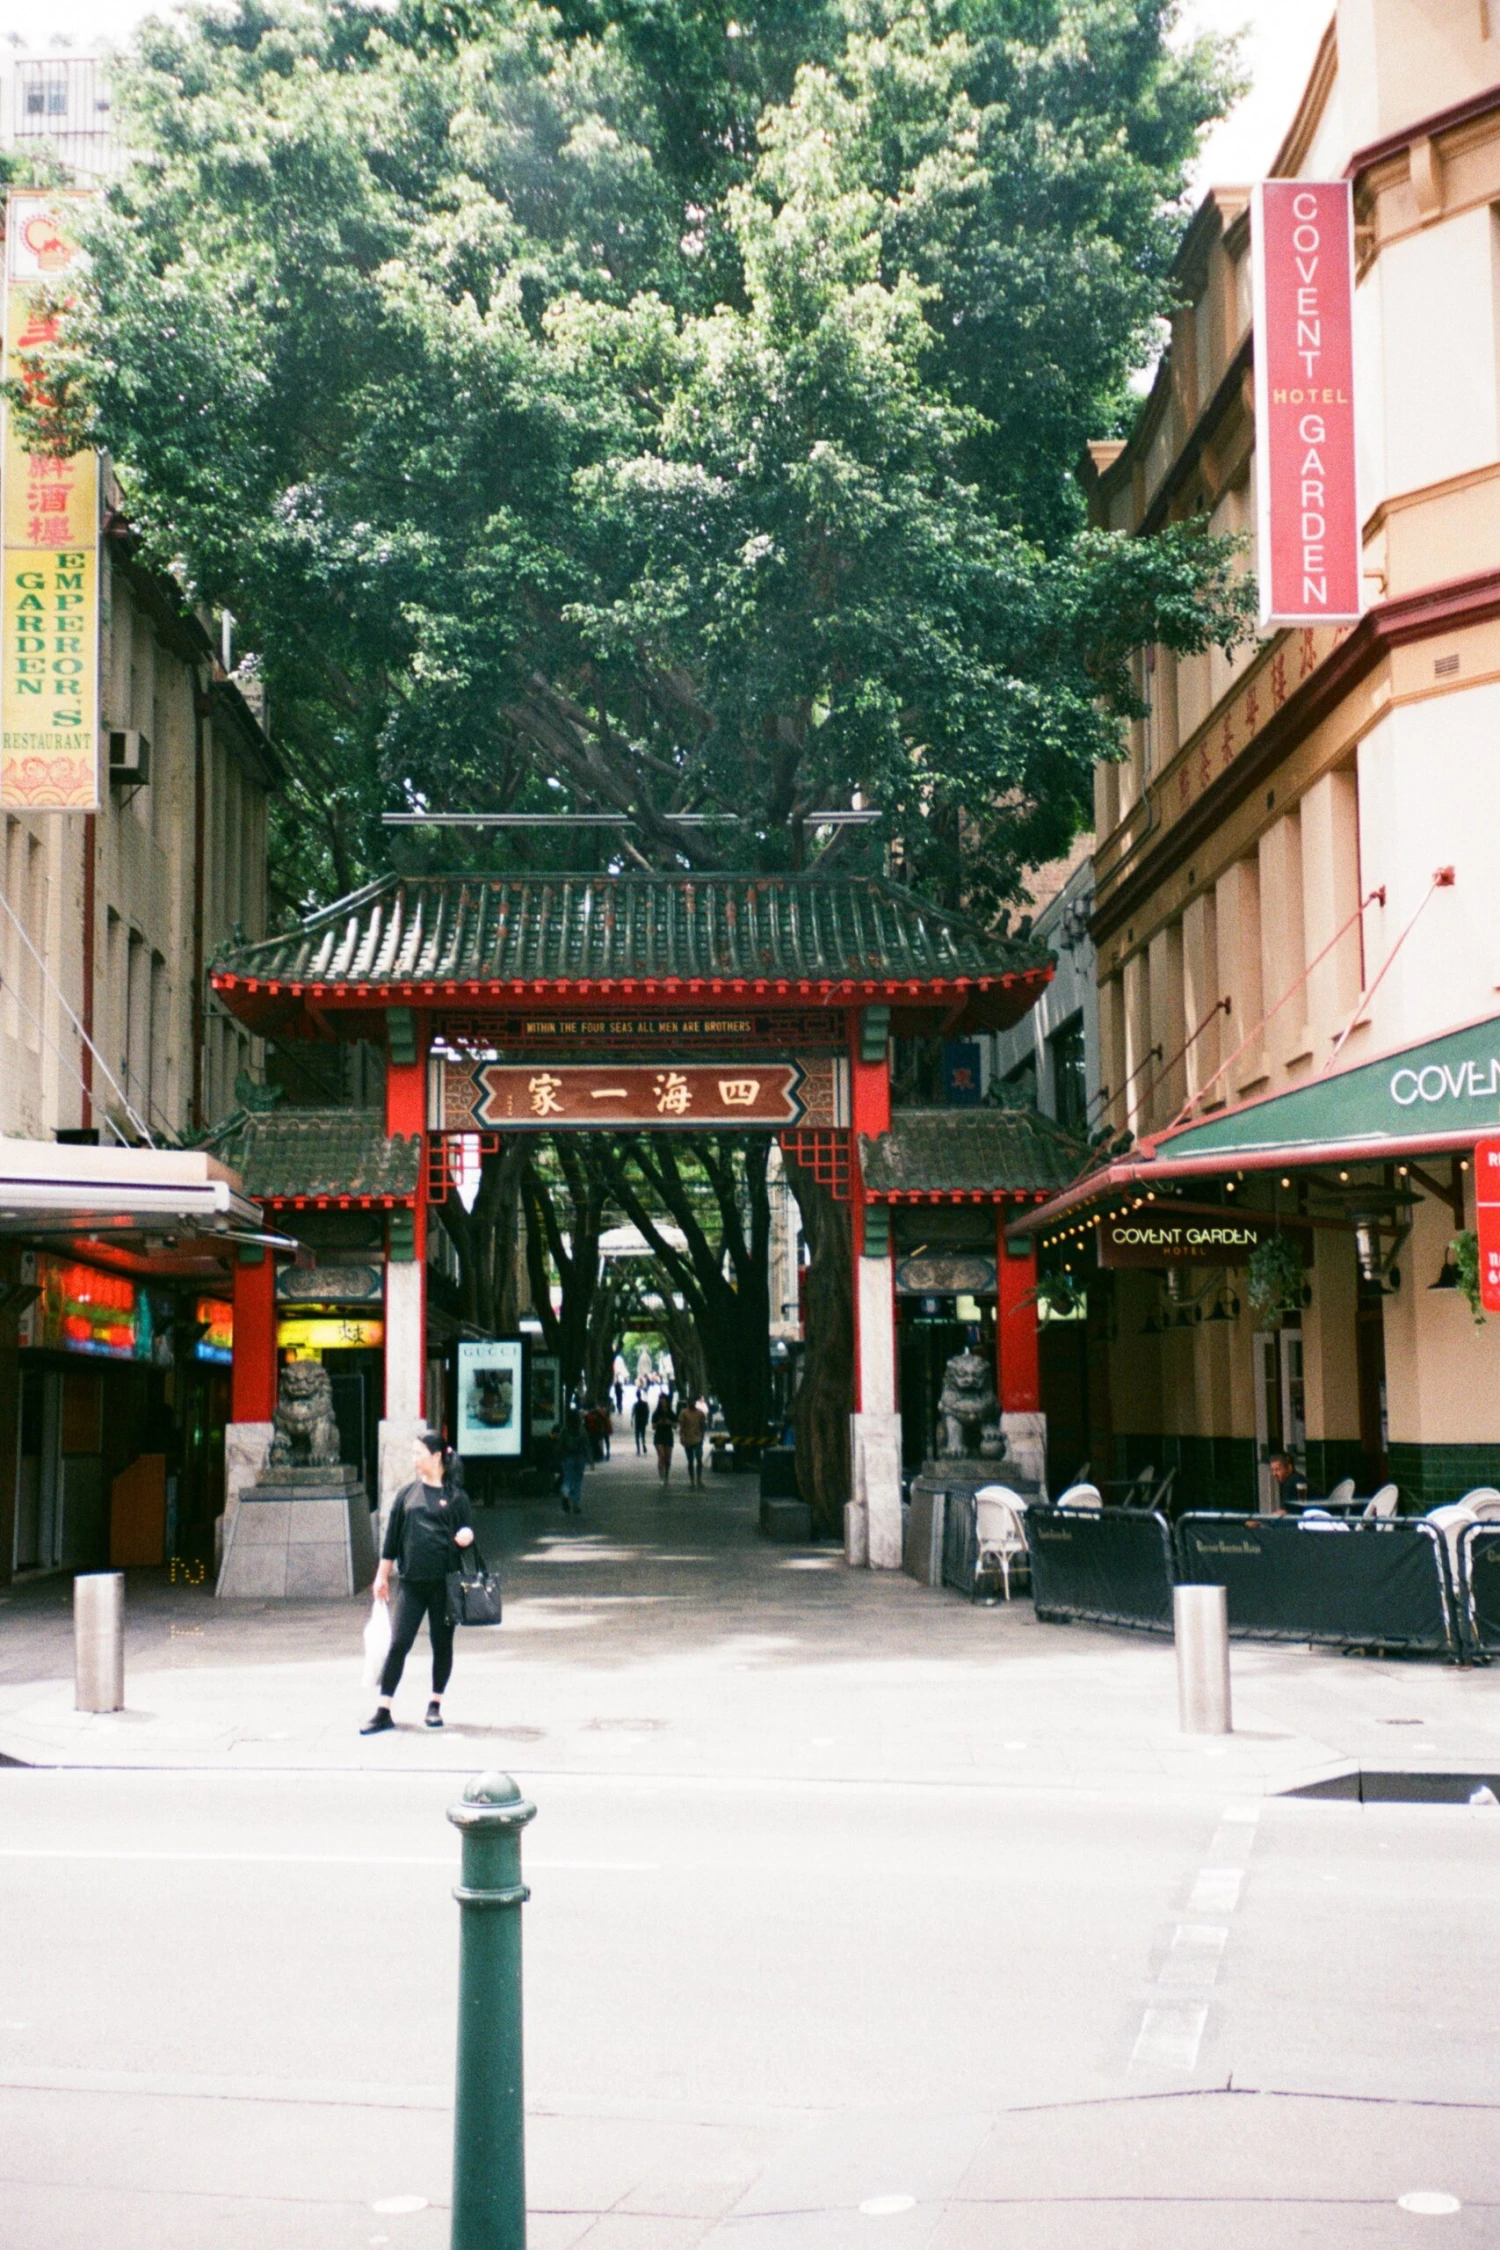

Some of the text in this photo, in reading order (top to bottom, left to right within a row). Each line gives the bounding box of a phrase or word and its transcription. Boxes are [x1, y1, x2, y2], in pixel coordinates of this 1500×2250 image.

[1292, 193, 1322, 379] COVENT
[1273, 389, 1348, 404] HOTEL
[1299, 414, 1328, 605] GARDEN
[15, 572, 46, 696] GARDEN
[52, 553, 86, 727] EMPEROR'S
[3, 733, 91, 750] RESTAURANT
[526, 1021, 751, 1033] WITHIN THE FOUR SEAS ALL MEN ARE BROTHERS
[1112, 1228, 1257, 1244] COVENT GARDEN
[1163, 1246, 1206, 1256] HOTEL
[463, 1347, 517, 1357] GUCCI
